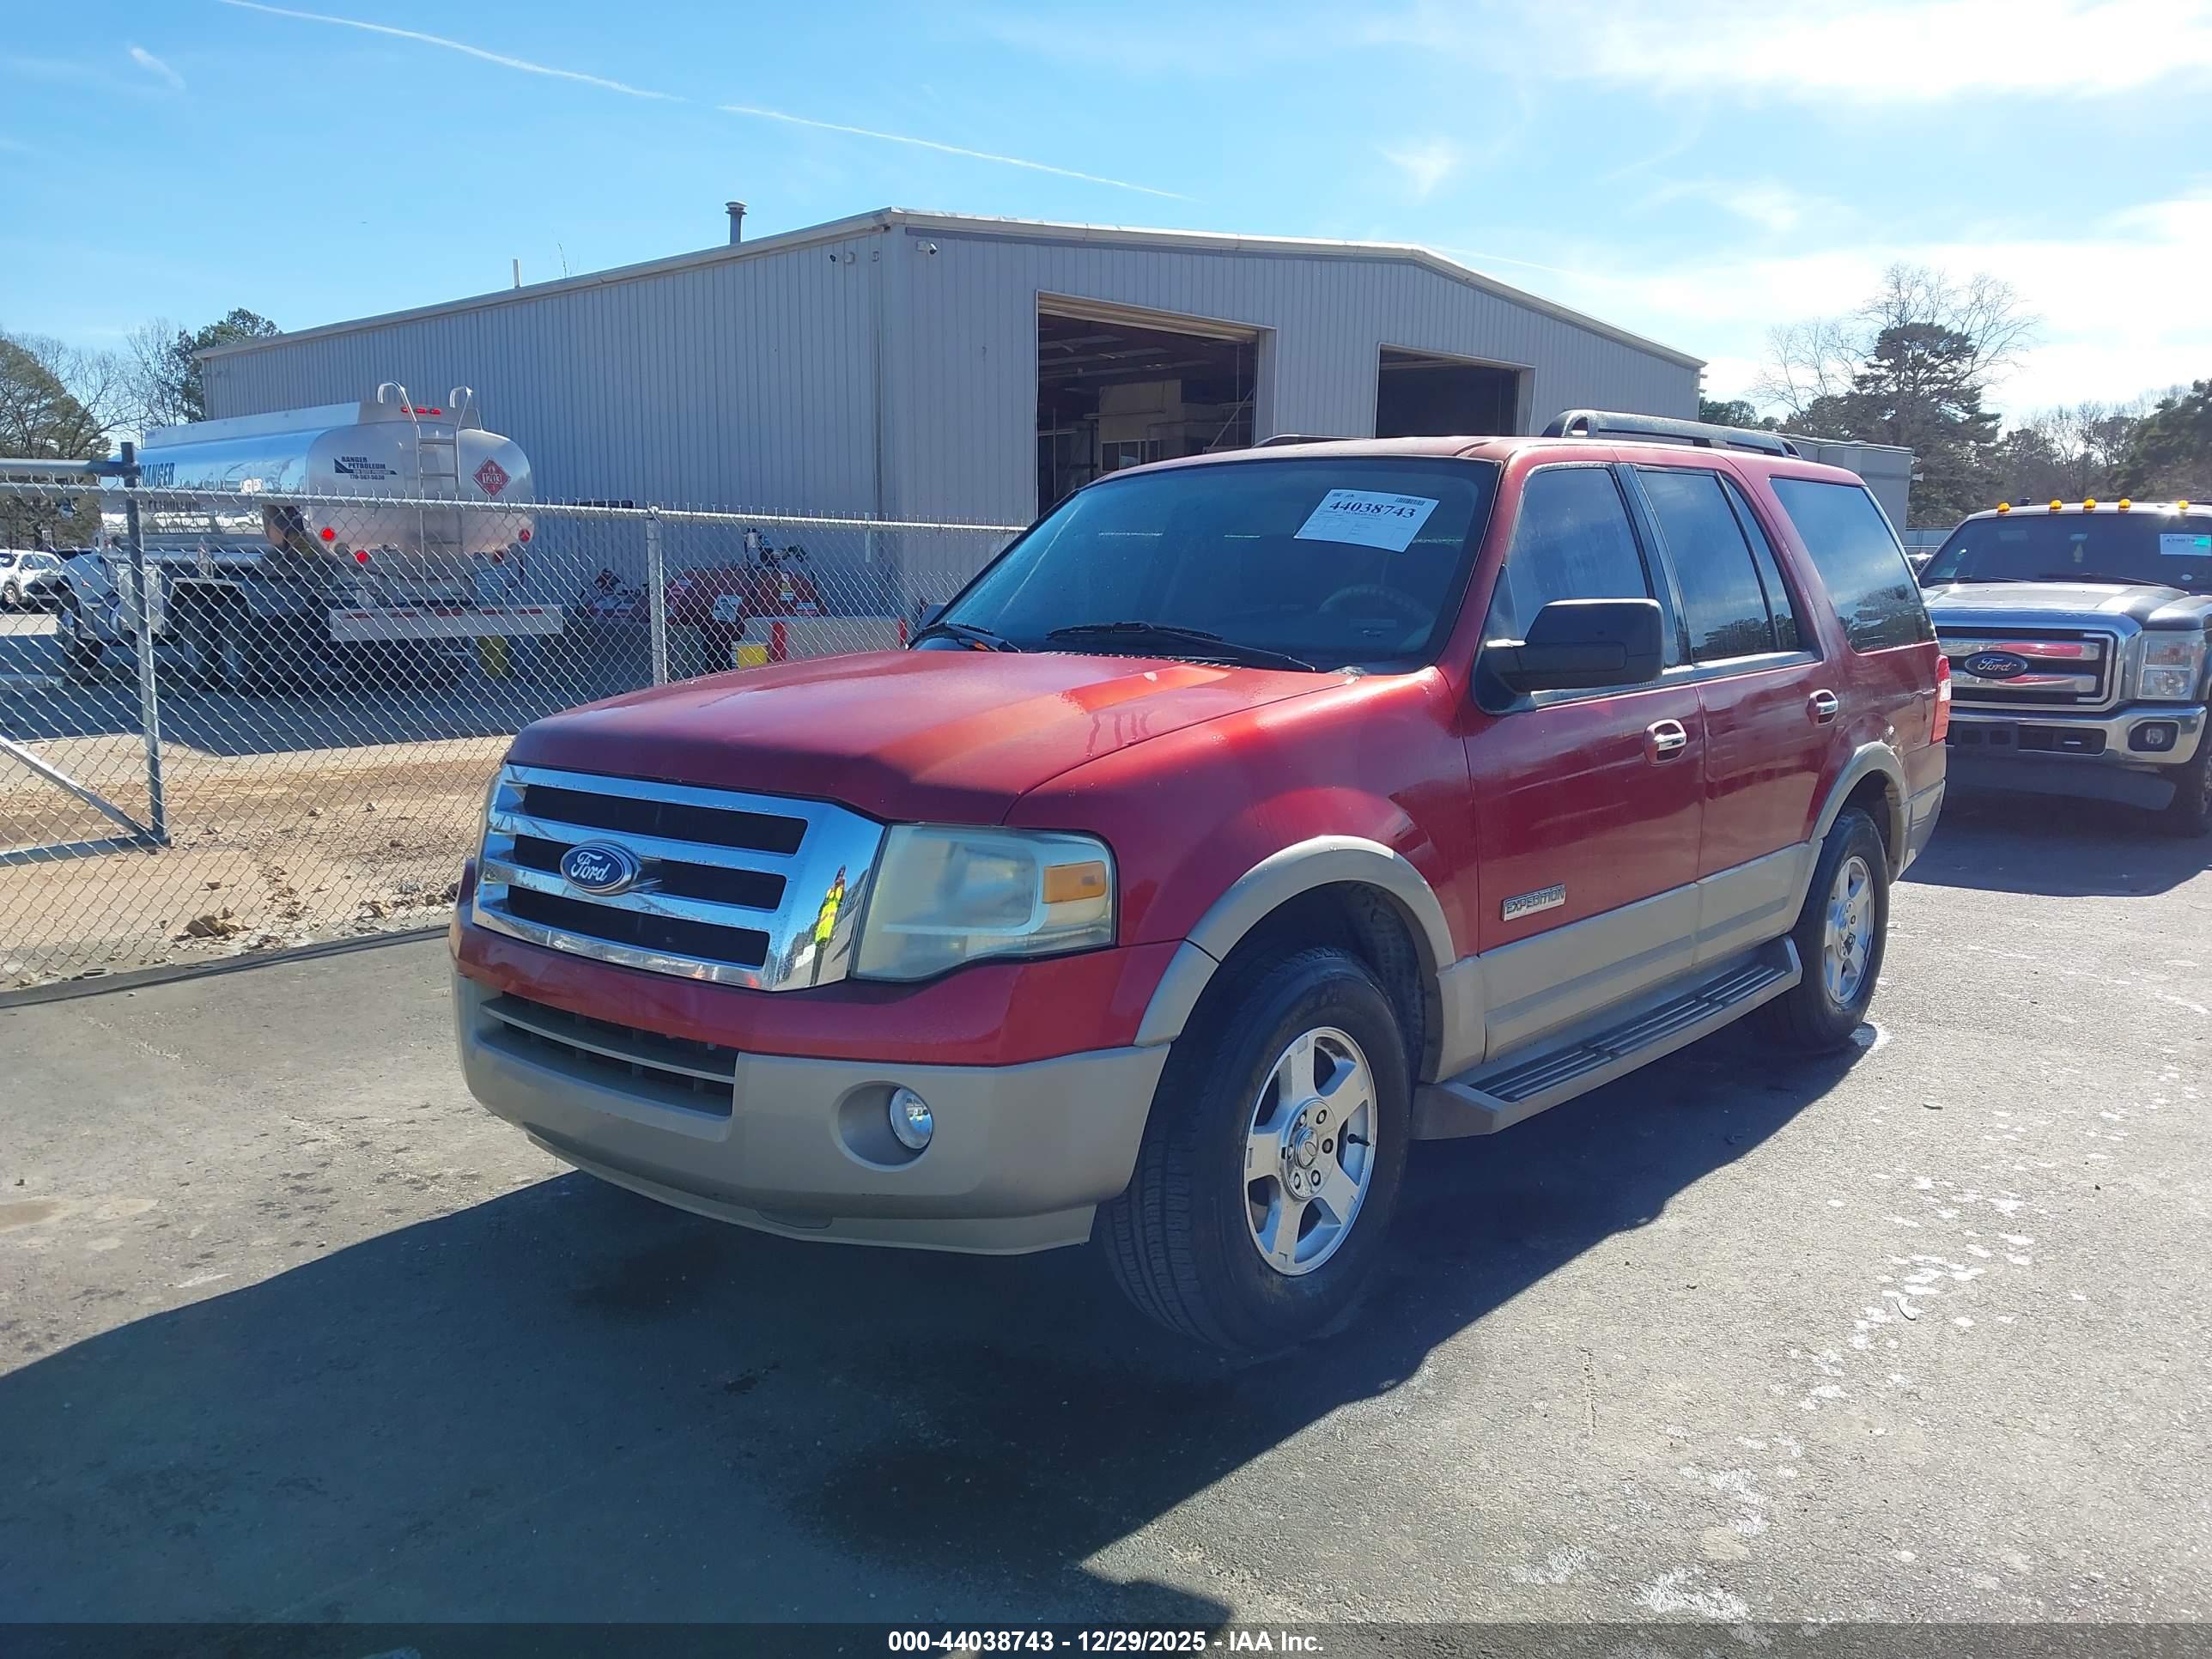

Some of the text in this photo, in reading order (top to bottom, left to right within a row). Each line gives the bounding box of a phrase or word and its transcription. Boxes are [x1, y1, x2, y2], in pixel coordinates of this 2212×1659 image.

[483, 473, 501, 483] 1203
[1329, 501, 1416, 519] 44038743
[1978, 657, 2017, 672] Ford
[570, 851, 611, 882] Ford
[1505, 888, 1565, 914] EXPEDITION
